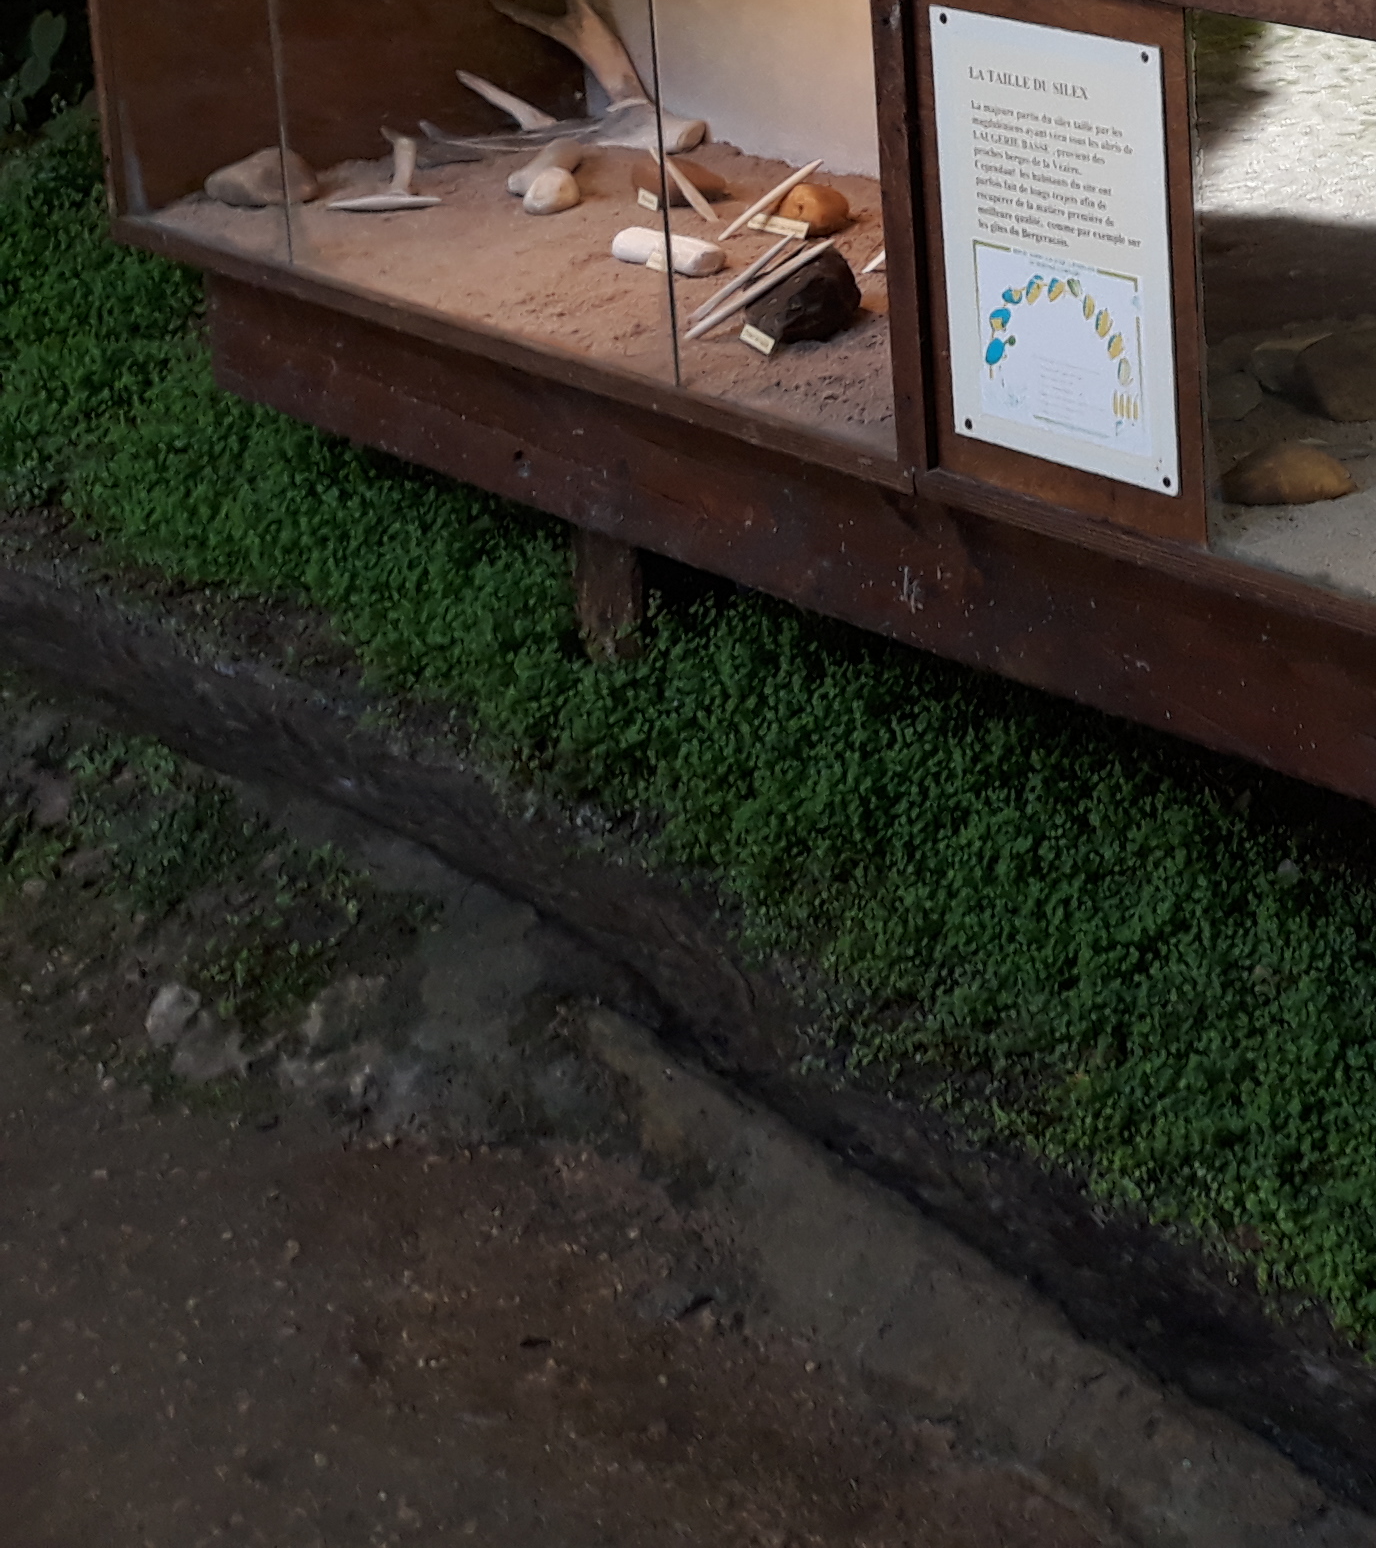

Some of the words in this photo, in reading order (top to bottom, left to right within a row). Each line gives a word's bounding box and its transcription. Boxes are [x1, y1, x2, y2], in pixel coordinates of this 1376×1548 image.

[969, 66, 985, 80] LA
[987, 70, 1030, 89] TAILLE
[1034, 78, 1046, 91] DU
[1053, 83, 1089, 99] SILEX
